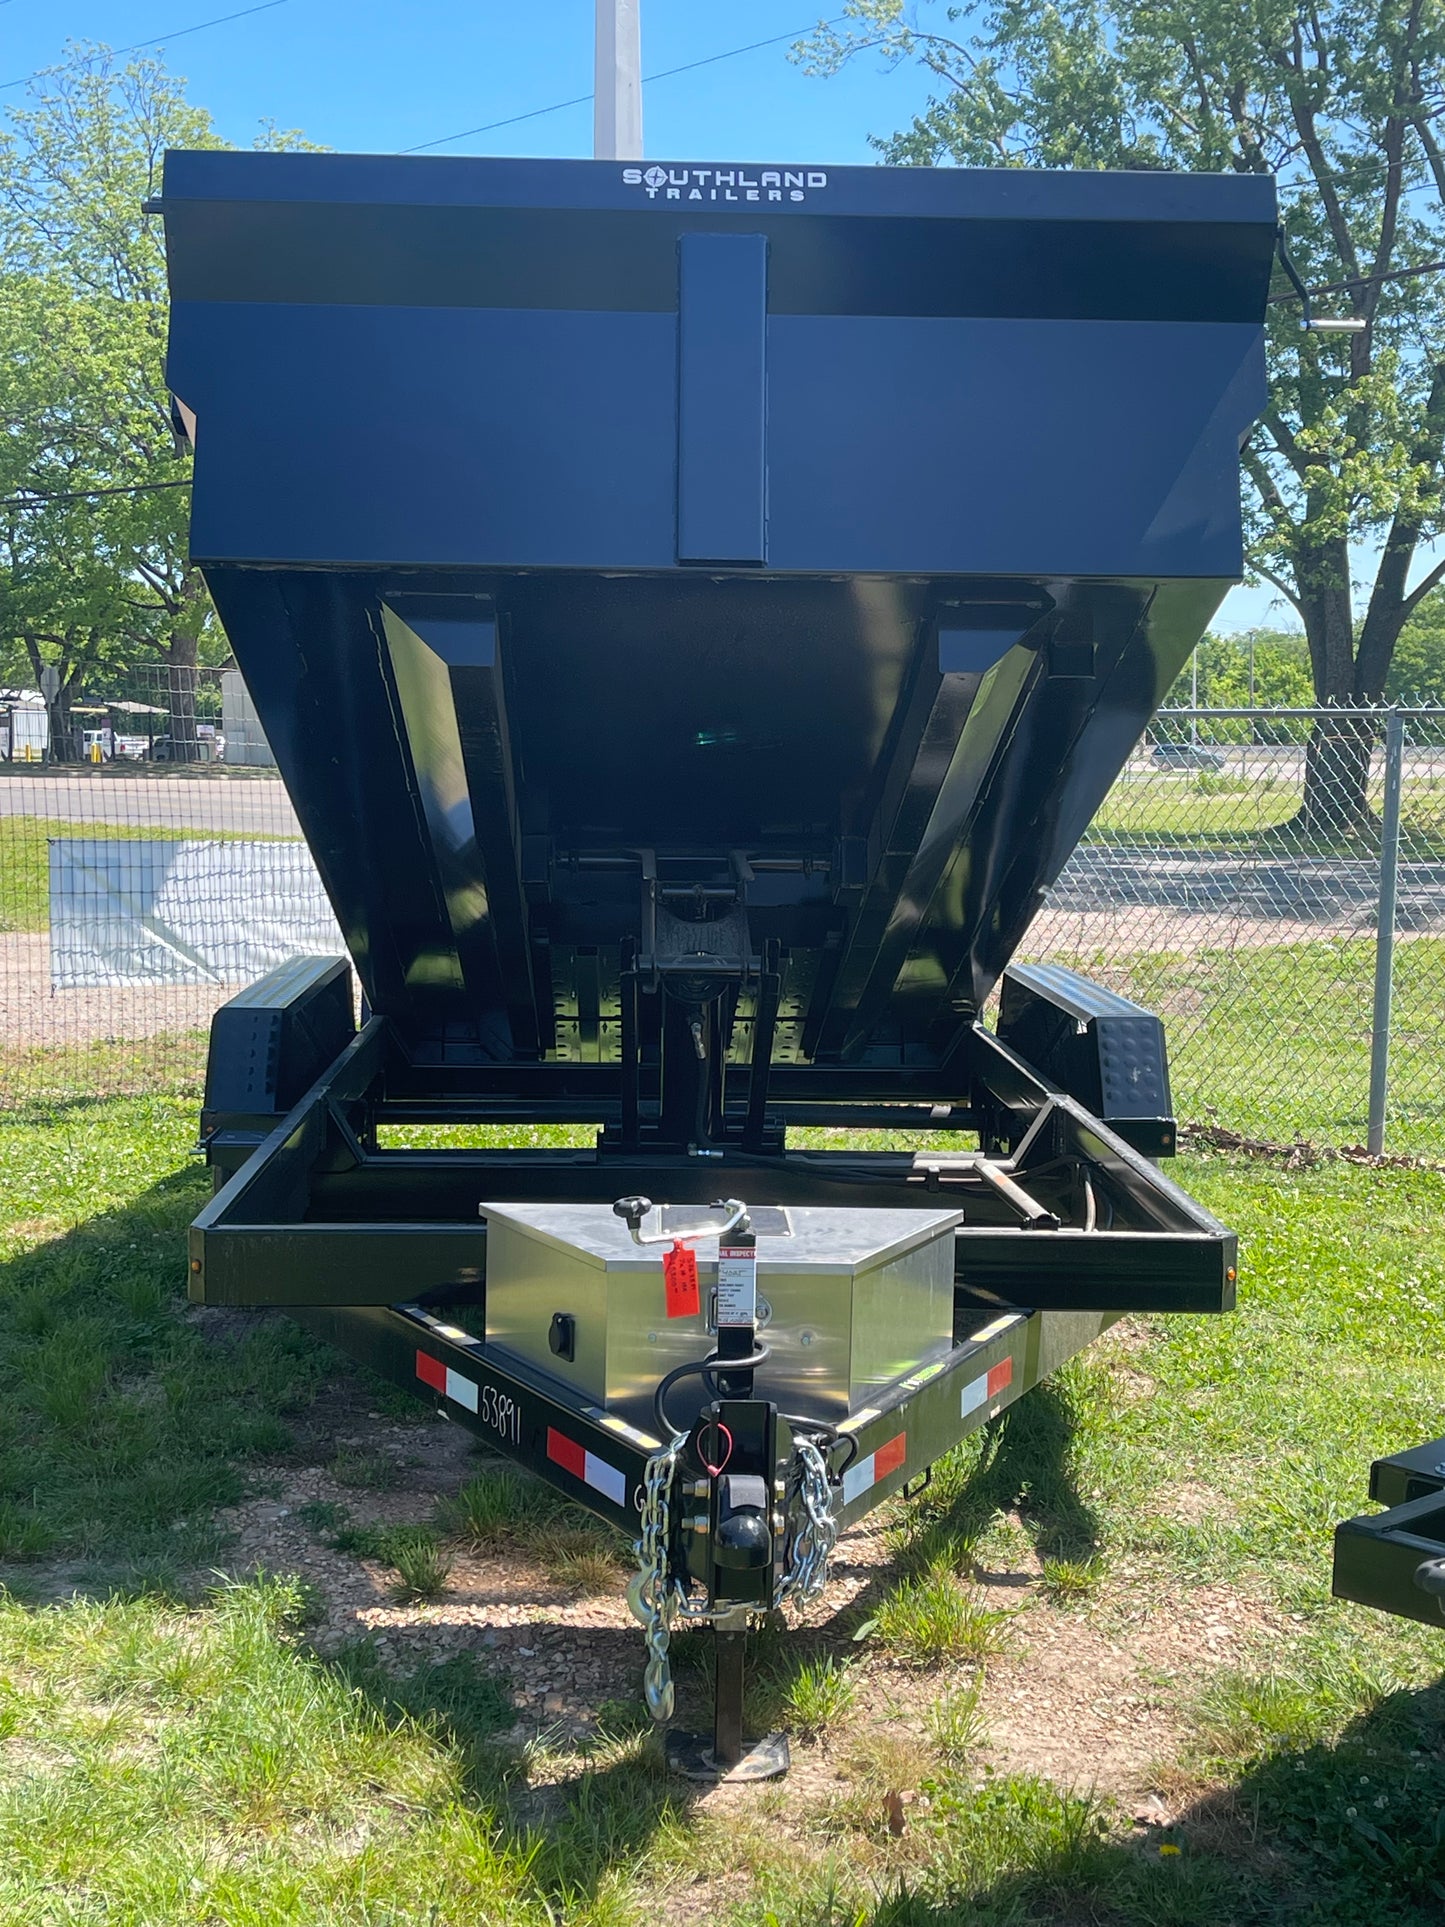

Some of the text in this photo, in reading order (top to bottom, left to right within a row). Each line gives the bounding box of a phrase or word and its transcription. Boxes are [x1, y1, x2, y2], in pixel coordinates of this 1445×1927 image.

[623, 166, 827, 188] SOUTHLAND
[645, 187, 805, 201] TRAILERS
[482, 1386, 521, 1446] 53891
